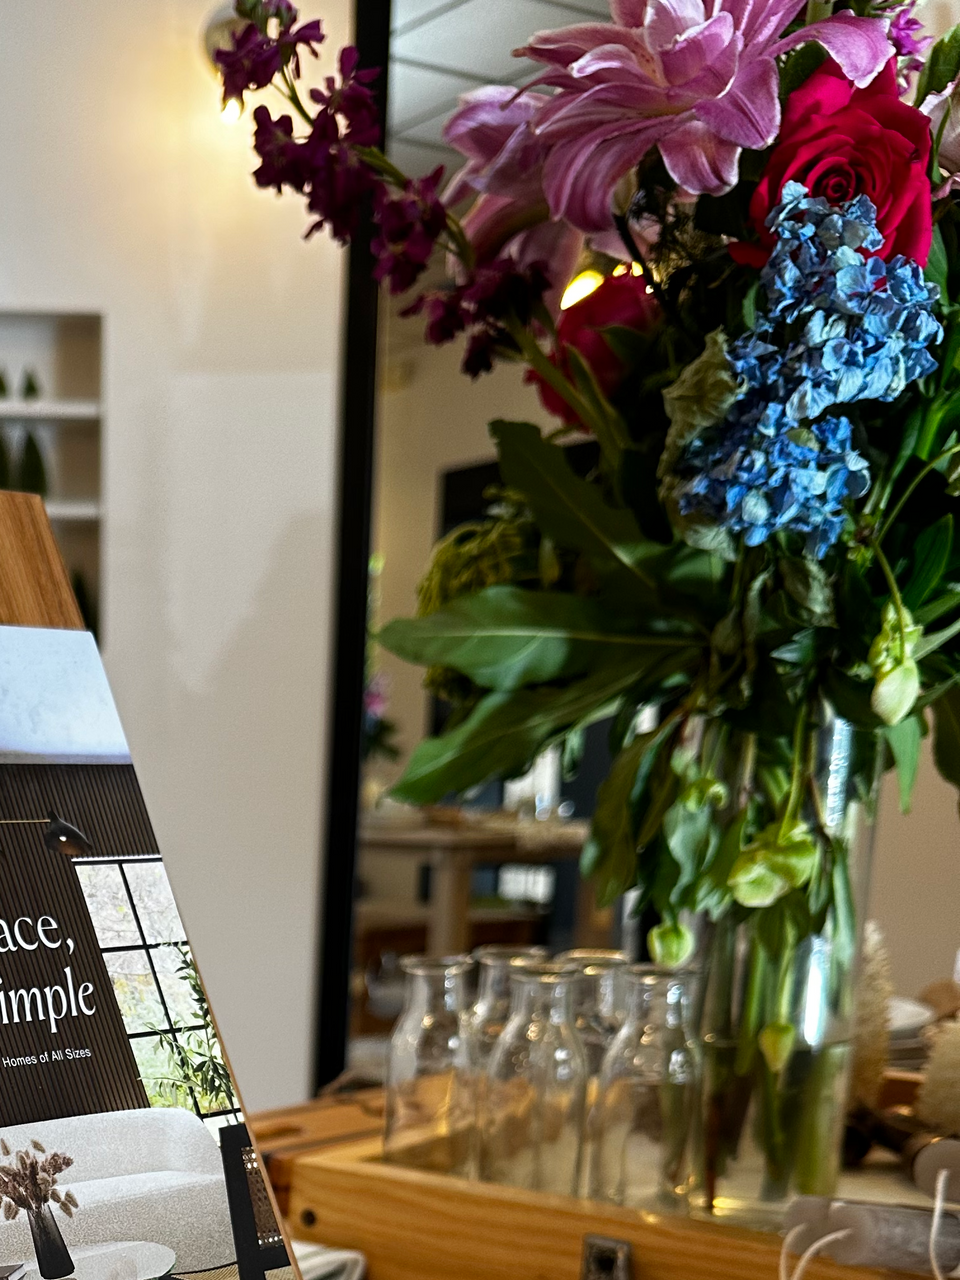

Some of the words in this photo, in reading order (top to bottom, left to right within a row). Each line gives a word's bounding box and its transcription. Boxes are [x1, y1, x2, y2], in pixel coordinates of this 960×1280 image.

[1, 1055, 38, 1068] Homes
[39, 1051, 50, 1063] of
[51, 1050, 64, 1062] All
[65, 1048, 92, 1060] Sizes
